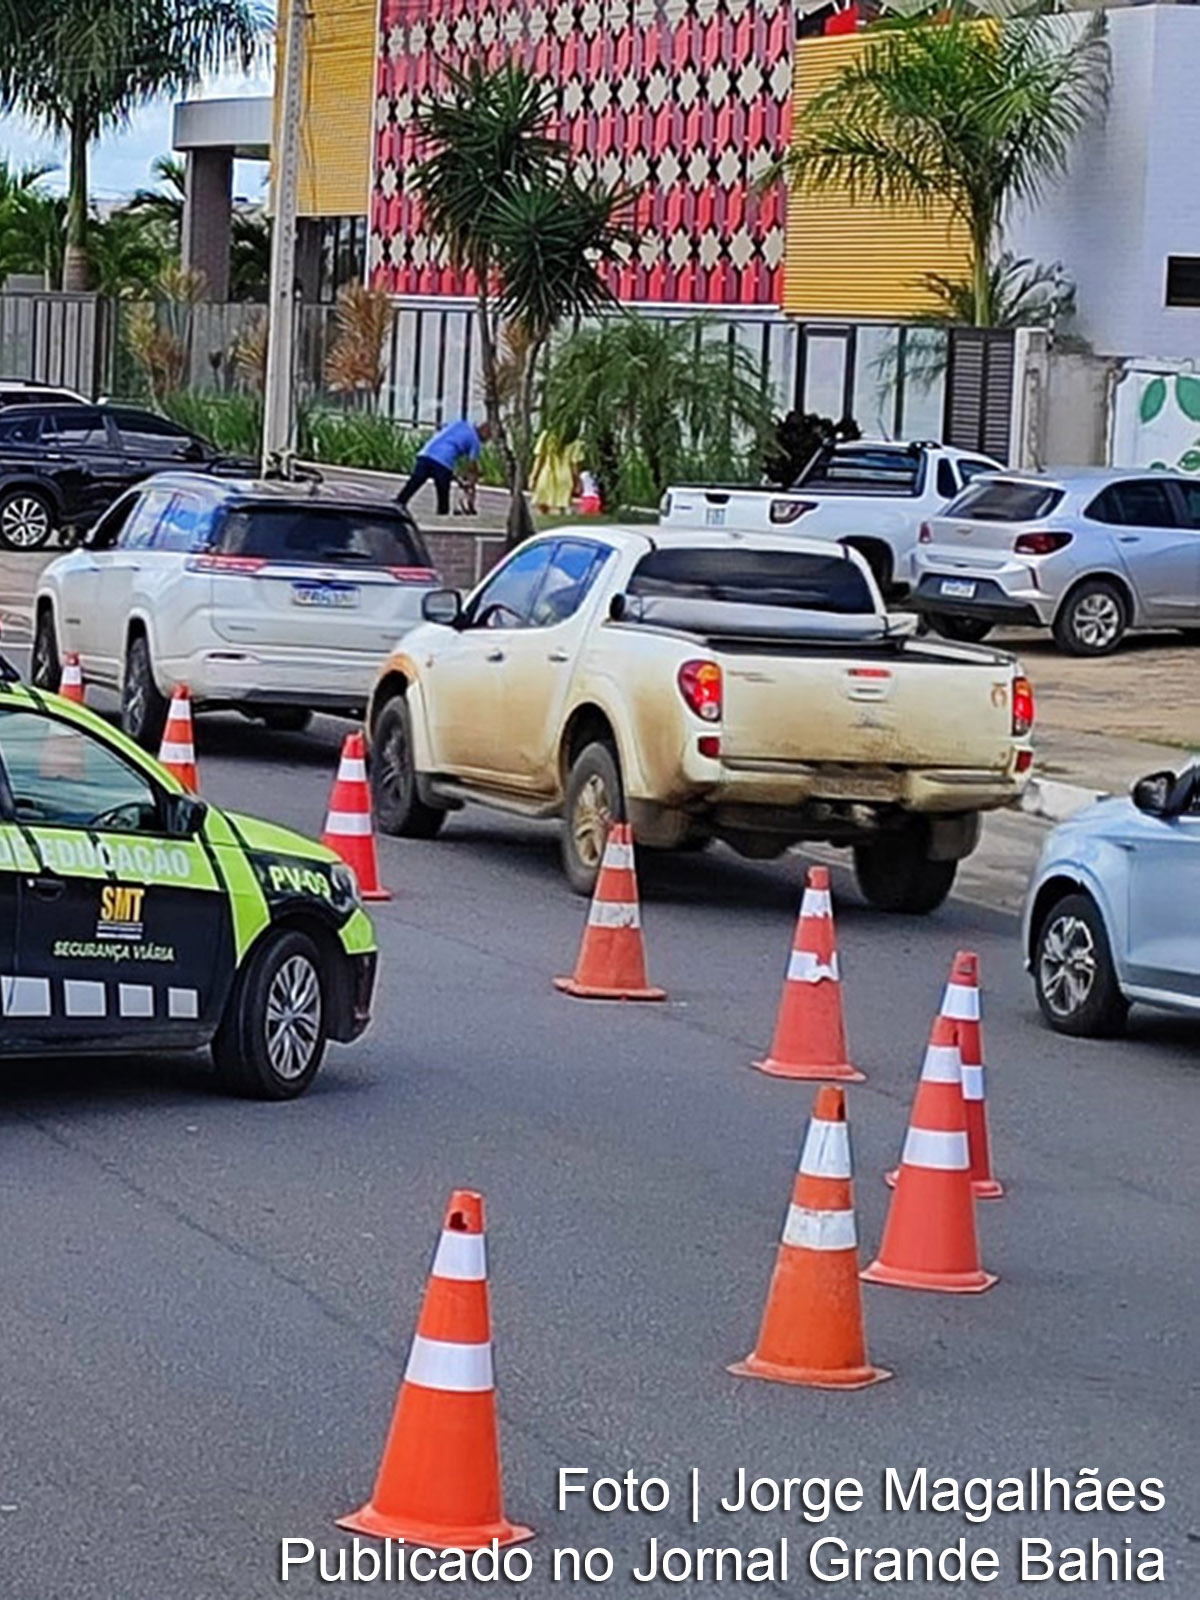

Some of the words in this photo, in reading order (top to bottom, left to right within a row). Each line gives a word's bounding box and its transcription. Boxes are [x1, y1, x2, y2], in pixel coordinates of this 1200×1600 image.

[40, 836, 192, 881] EDUCAÇÃO
[268, 864, 332, 899] PV-09
[101, 886, 145, 921] SMT
[53, 941, 131, 962] SEGURANÇA
[133, 942, 176, 961] VIÁRIA
